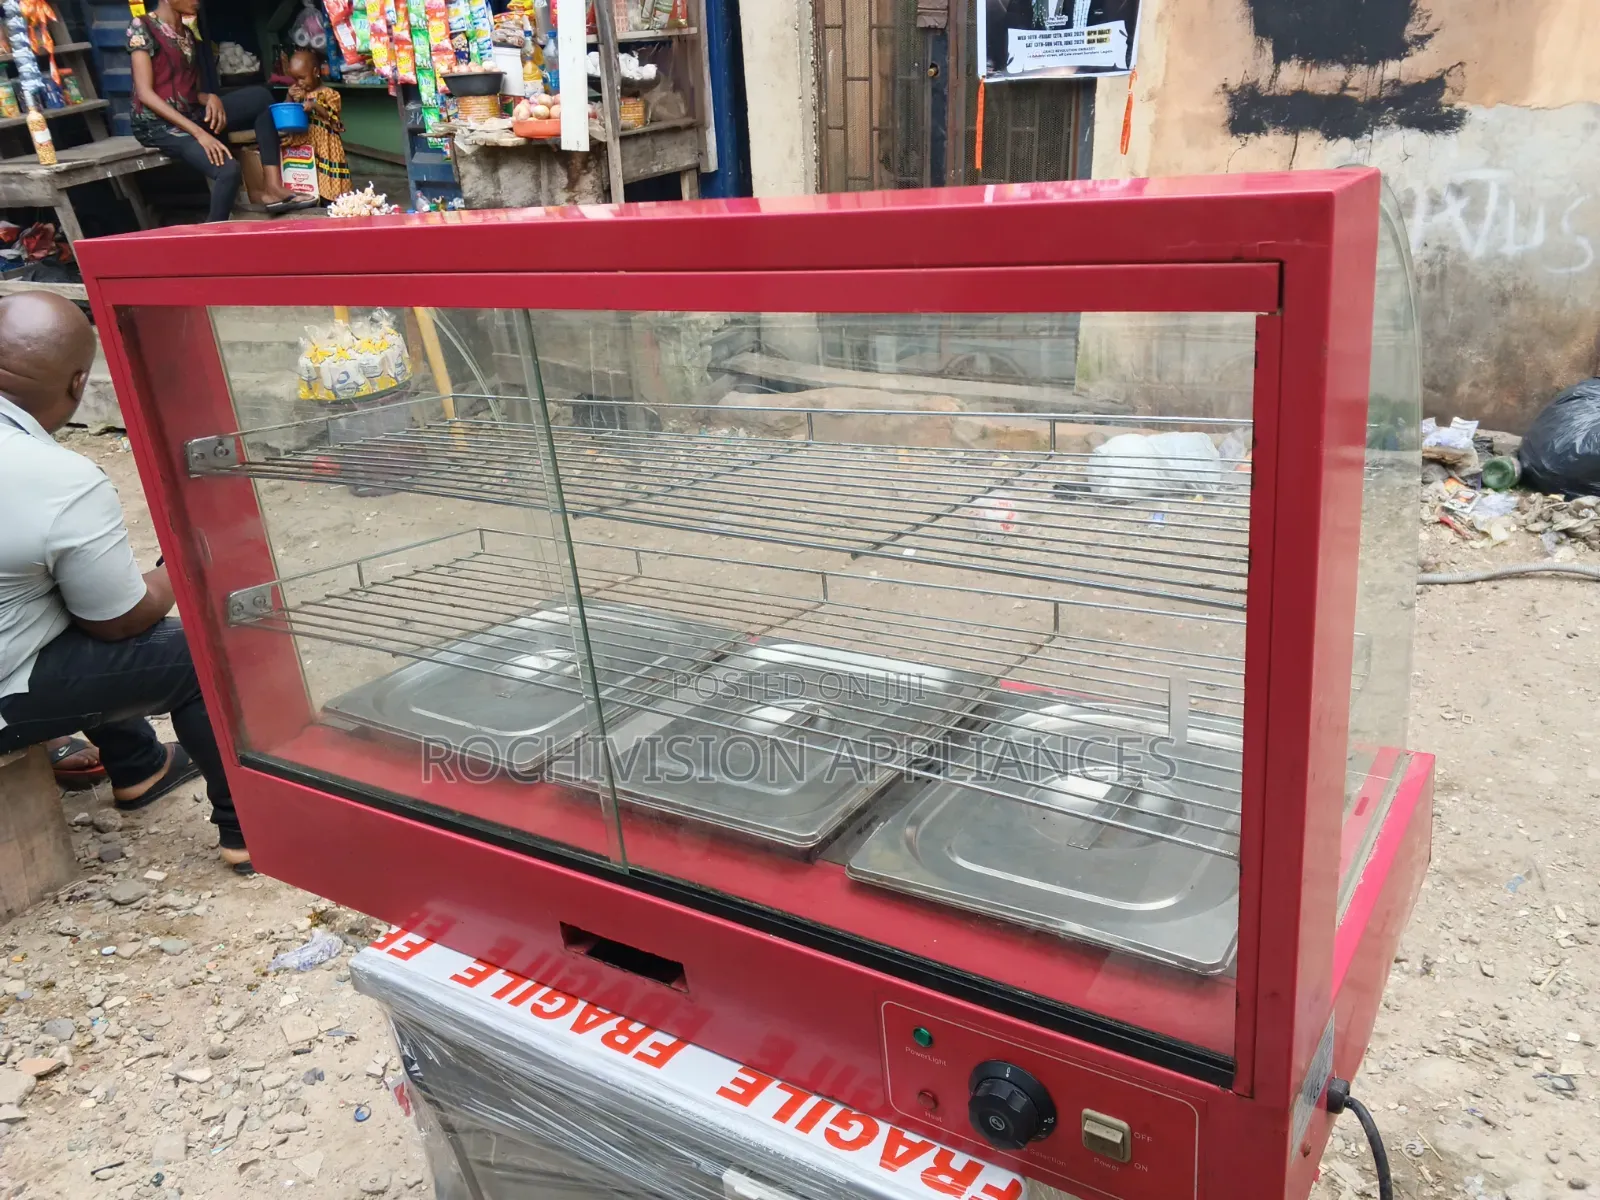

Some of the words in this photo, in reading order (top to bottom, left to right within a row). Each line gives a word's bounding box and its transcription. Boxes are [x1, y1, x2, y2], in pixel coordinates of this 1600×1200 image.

[449, 958, 691, 1070] FRAGILE
[1133, 1131, 1153, 1143] OFF
[1093, 1157, 1120, 1172] Power
[1133, 1162, 1149, 1173] ON
